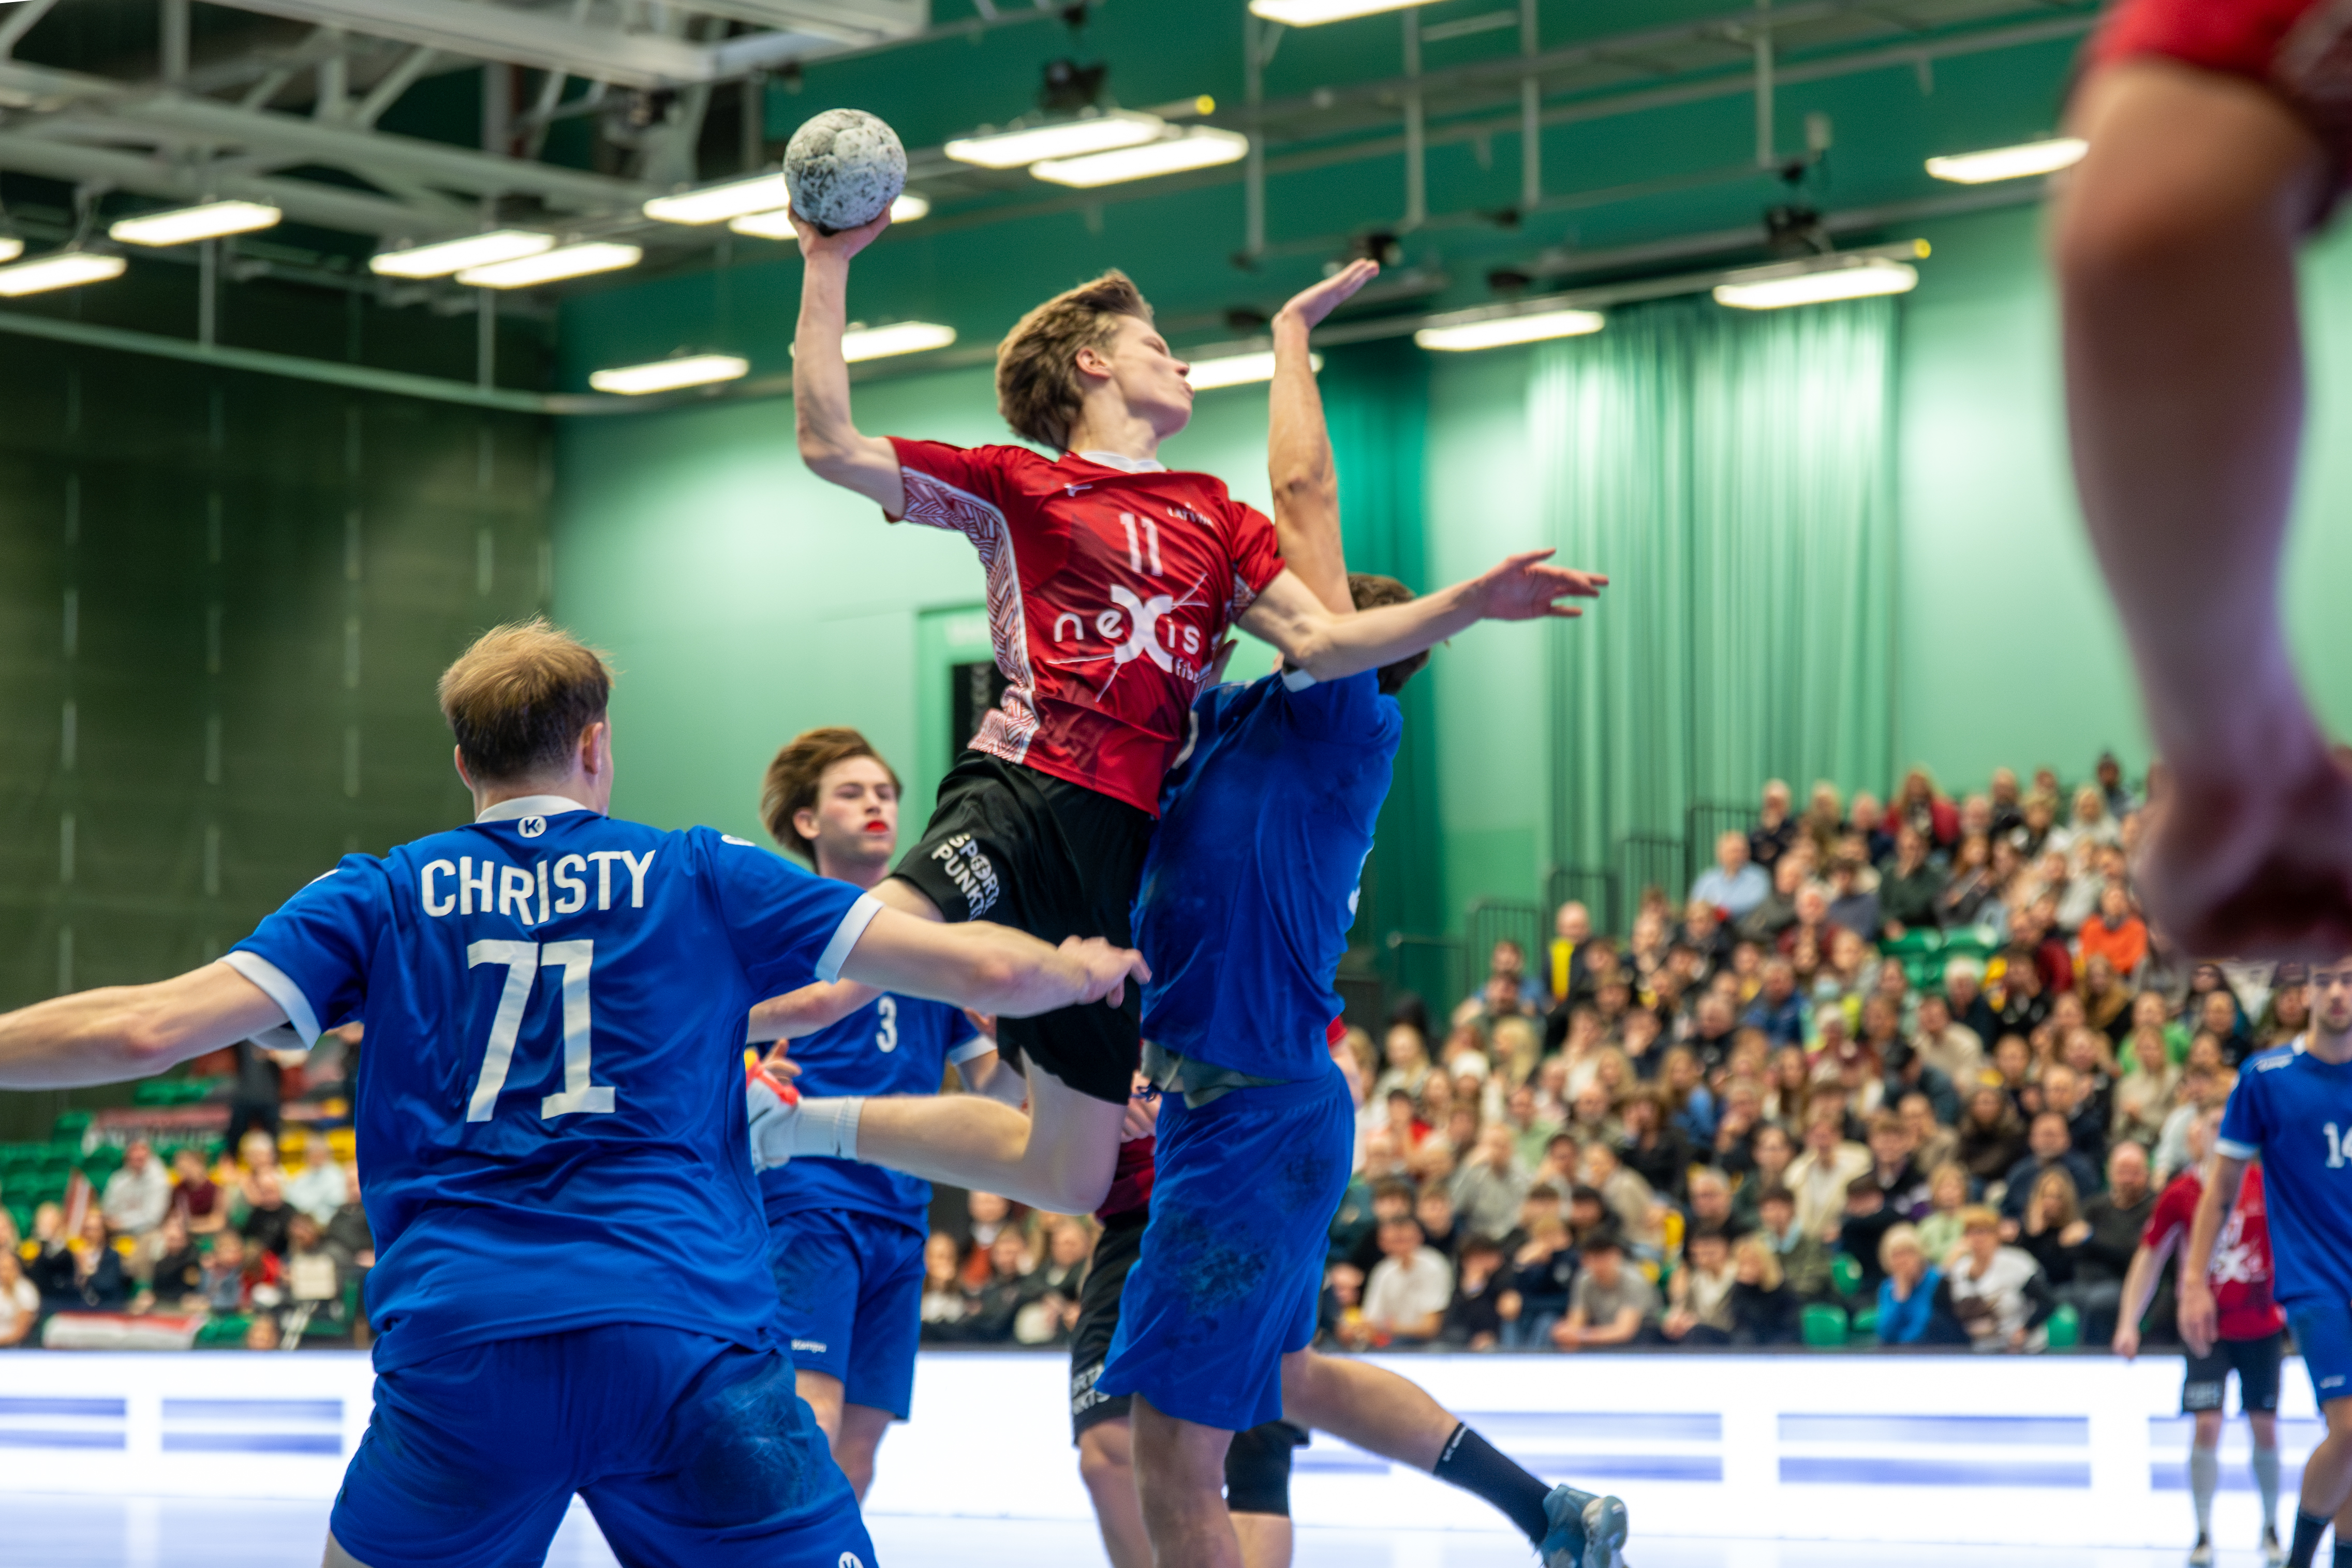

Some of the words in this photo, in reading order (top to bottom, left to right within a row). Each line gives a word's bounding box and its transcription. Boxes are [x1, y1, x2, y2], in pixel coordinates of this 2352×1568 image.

[1119, 511, 1163, 576] 11
[421, 850, 656, 925] CHRISTY
[467, 939, 616, 1122] 71
[876, 996, 897, 1053] 3
